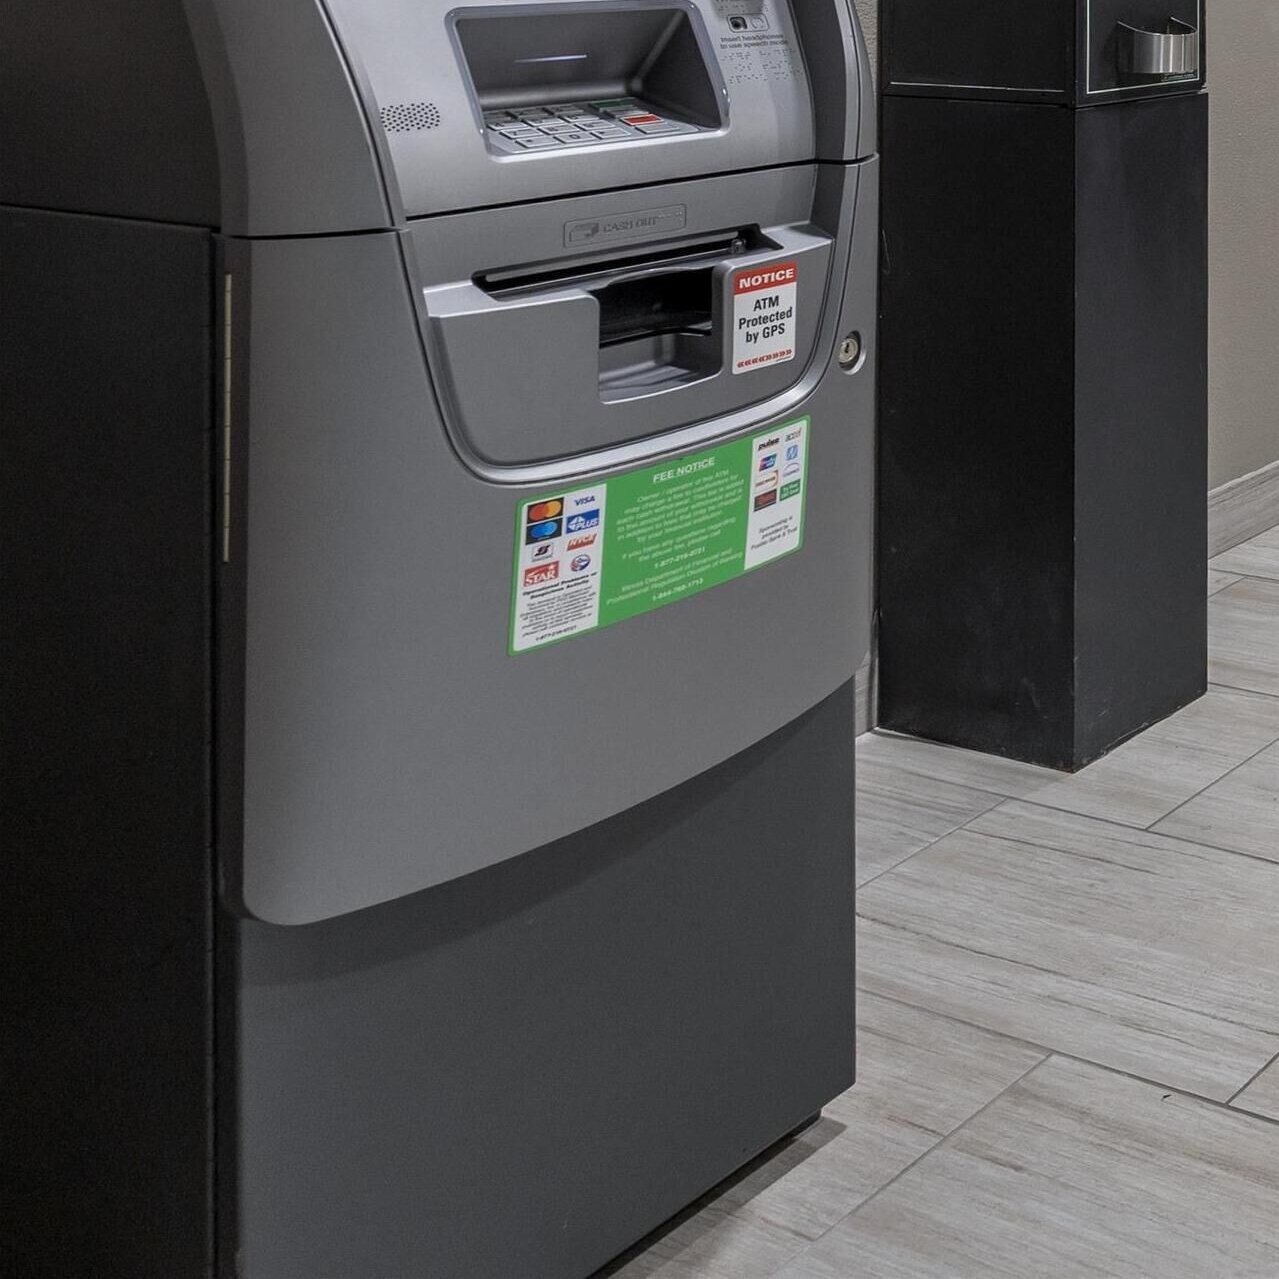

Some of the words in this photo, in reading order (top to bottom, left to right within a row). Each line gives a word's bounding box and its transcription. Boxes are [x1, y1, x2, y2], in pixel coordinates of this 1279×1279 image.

[739, 268, 794, 289] NOTICE
[754, 295, 779, 312] ATM
[739, 307, 793, 330] Protected
[746, 331, 759, 344] by
[762, 323, 785, 339] GPS
[653, 468, 673, 484] FEE
[676, 455, 715, 476] NOTICE
[574, 496, 595, 506] VISA
[575, 517, 598, 531] PLUS
[525, 570, 556, 586] STAR
